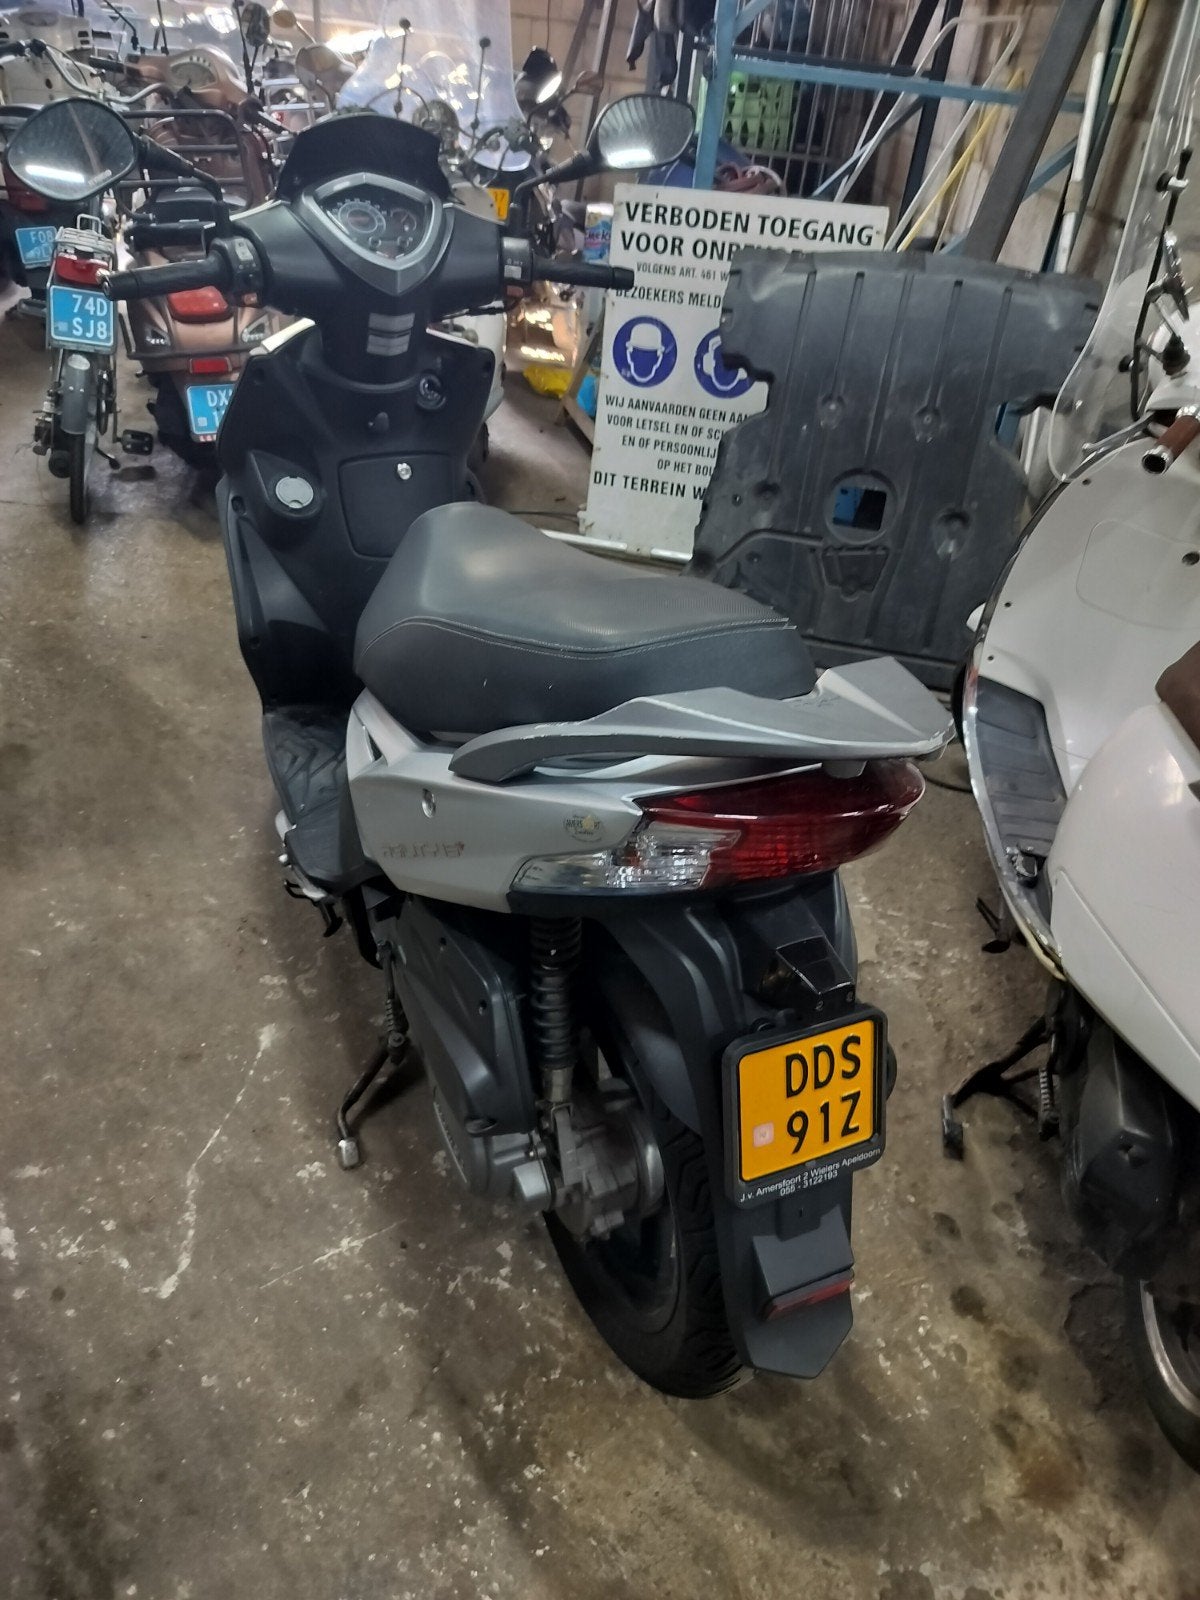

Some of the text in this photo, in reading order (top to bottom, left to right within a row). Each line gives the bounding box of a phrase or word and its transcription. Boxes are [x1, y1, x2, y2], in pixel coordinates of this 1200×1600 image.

[626, 202, 874, 246] VERBODEN TOEGANG
[621, 231, 684, 257] VOOR
[637, 262, 676, 276] VOLGENS
[680, 267, 697, 278] ART.
[701, 270, 716, 280] 461
[72, 294, 108, 316] 74D
[688, 291, 722, 308] MELD
[72, 317, 108, 339] SJ8
[605, 395, 625, 407] WIJ
[627, 398, 696, 417] AANVAARDEN
[699, 407, 726, 422] GEEN
[607, 414, 633, 428] VOOR
[636, 418, 671, 433] LETSEL
[674, 424, 688, 436] EN
[691, 426, 704, 437] OF
[622, 435, 717, 458] EN OF PERSOONLIJ
[657, 459, 671, 470] OP
[673, 461, 692, 474] HET
[593, 471, 617, 487] DIT
[623, 475, 686, 498] TERREIN
[785, 1035, 861, 1098] DDS
[787, 1090, 861, 1154] 91Z
[756, 1174, 801, 1197] Amersfoort
[803, 1172, 809, 1182] 2
[779, 1185, 796, 1197] 055
